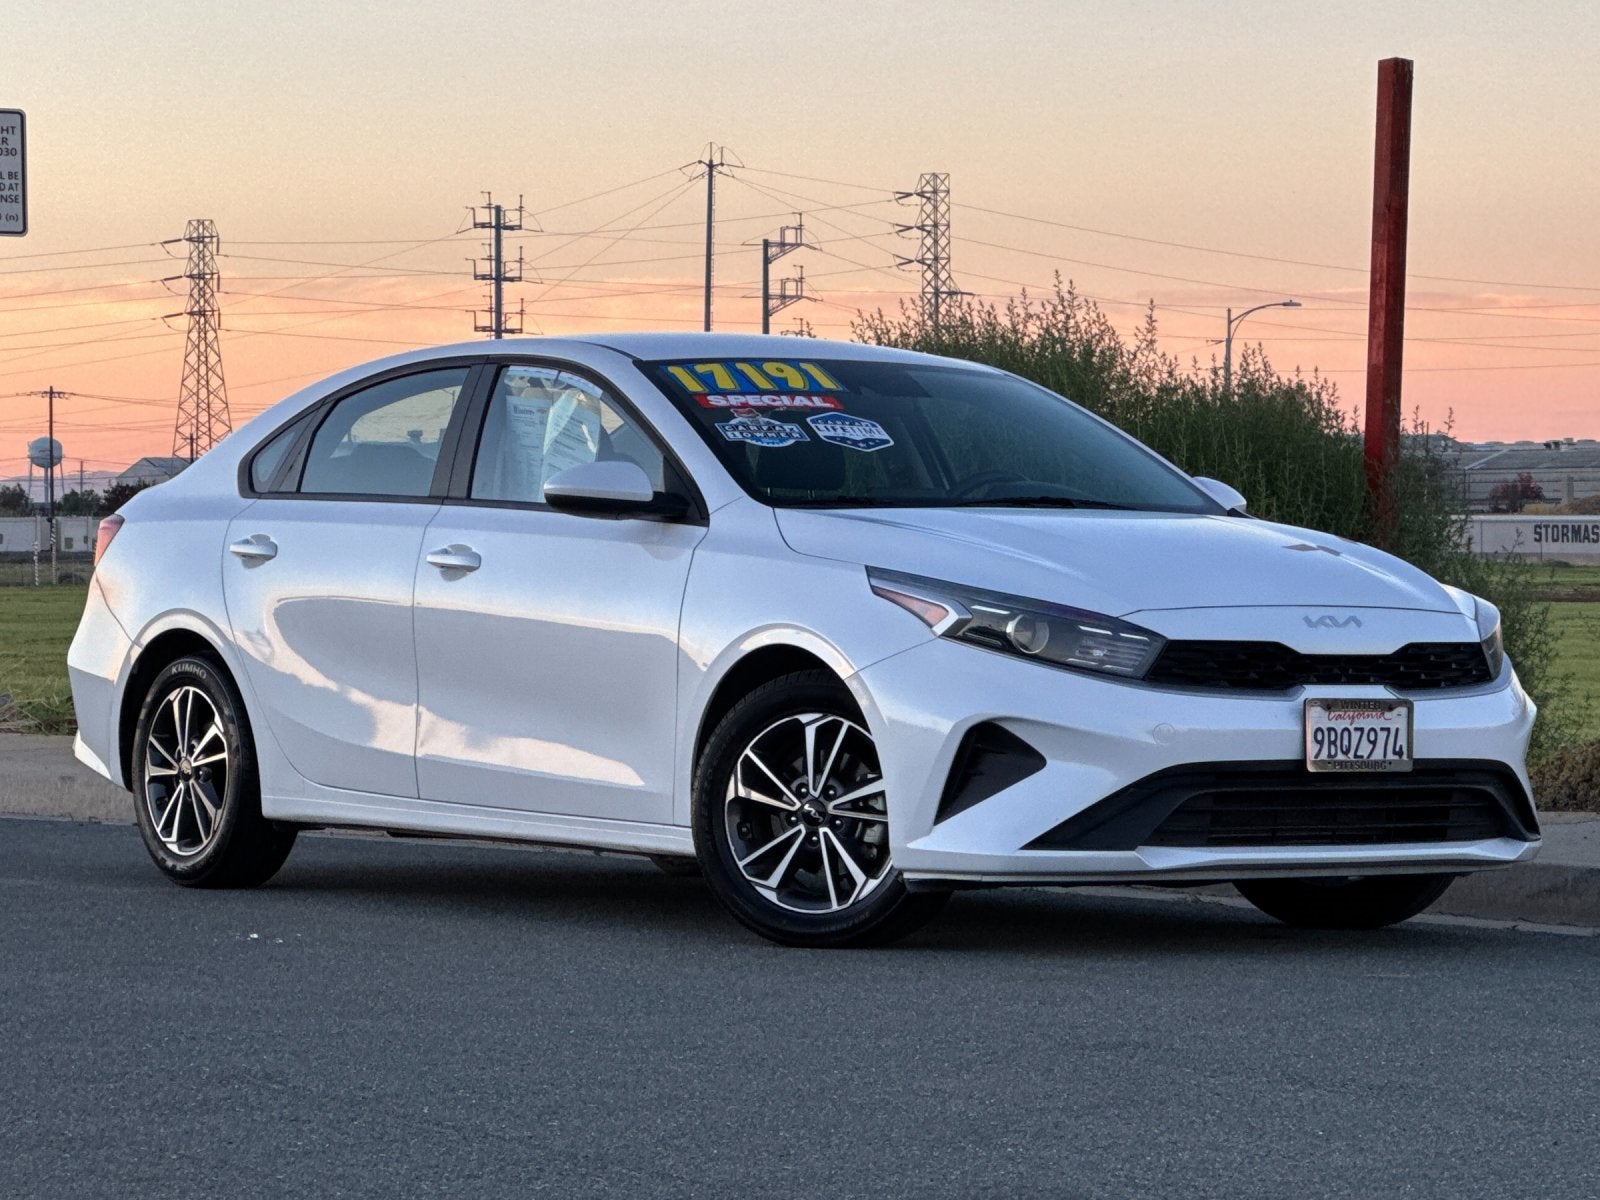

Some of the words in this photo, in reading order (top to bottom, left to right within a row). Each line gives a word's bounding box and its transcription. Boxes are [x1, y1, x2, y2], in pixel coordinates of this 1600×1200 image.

[7, 171, 19, 180] BE
[8, 182, 19, 192] AT
[667, 361, 843, 392] 17191
[706, 394, 834, 408] SPECIAL
[1533, 524, 1600, 543] STORMAS
[171, 663, 207, 679] KUMHO
[1327, 710, 1392, 726] California
[1313, 726, 1404, 760] 9BQZ974
